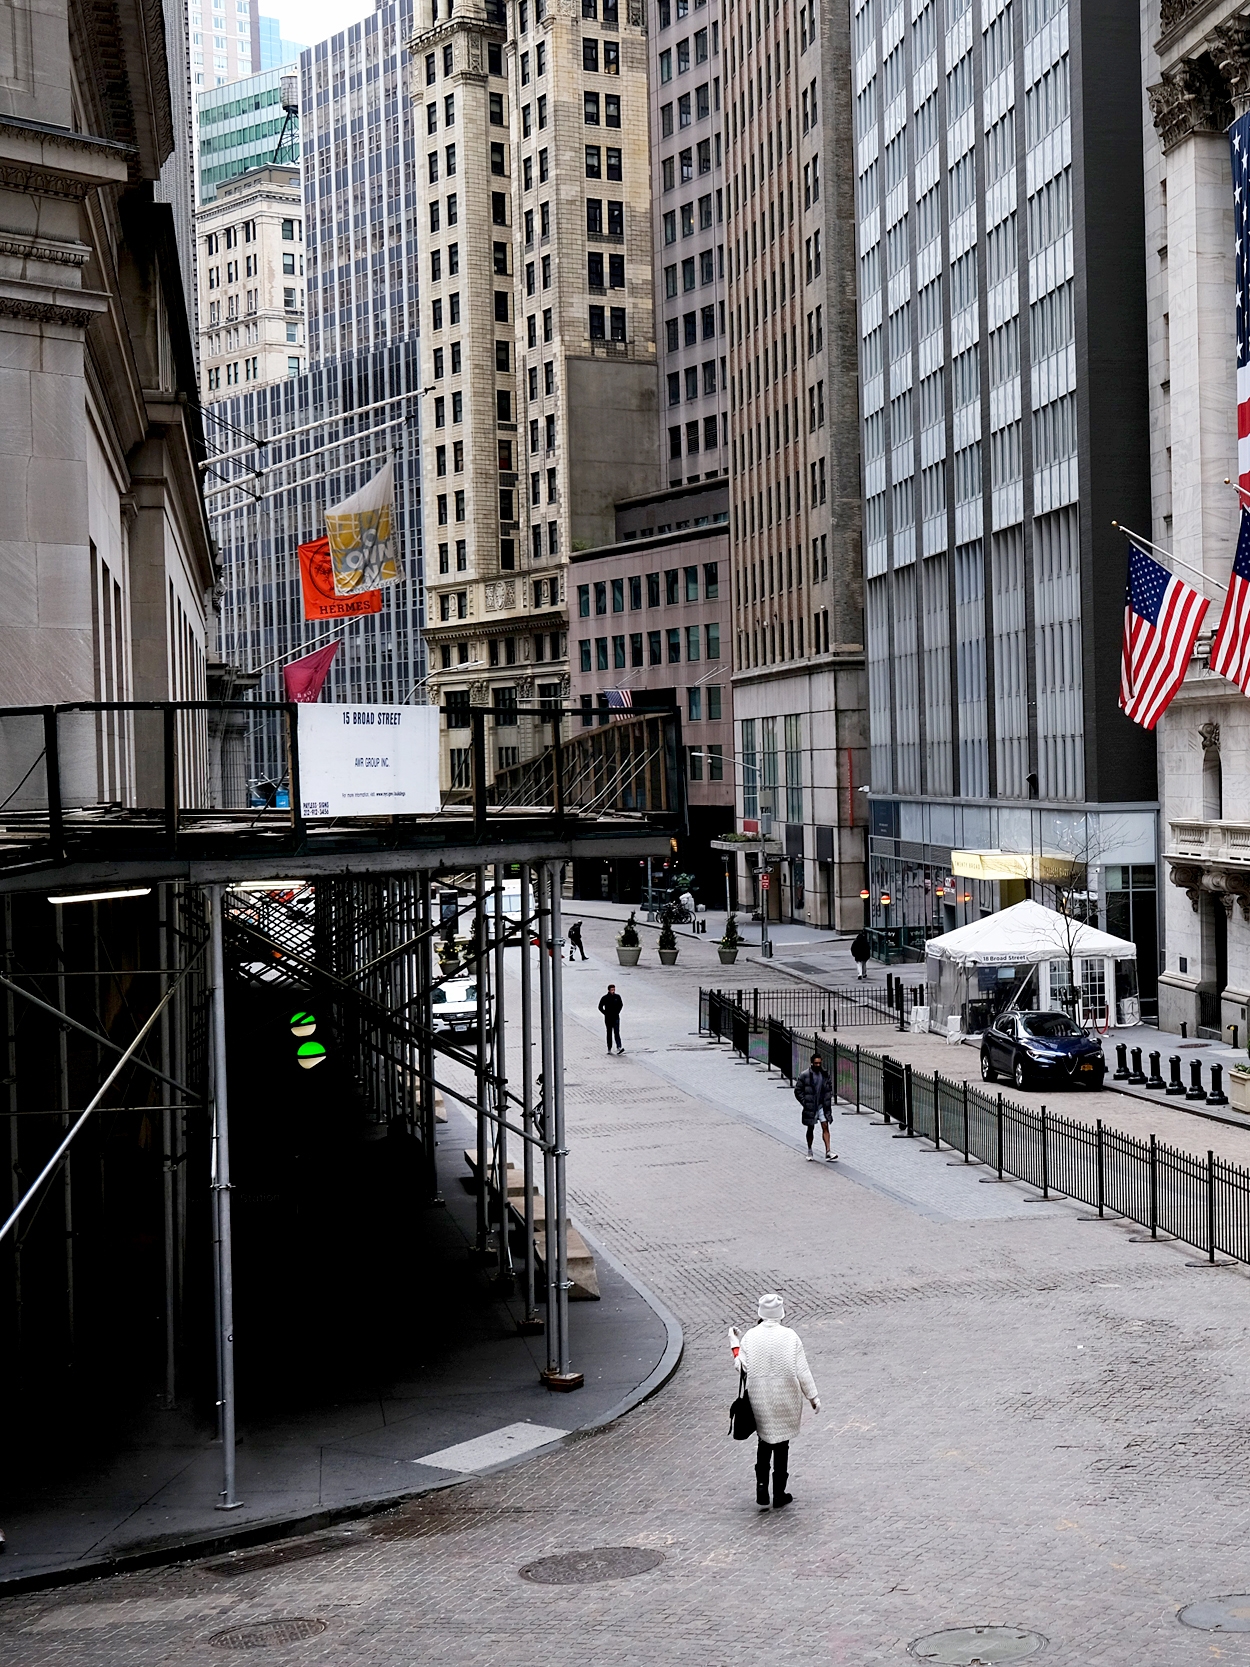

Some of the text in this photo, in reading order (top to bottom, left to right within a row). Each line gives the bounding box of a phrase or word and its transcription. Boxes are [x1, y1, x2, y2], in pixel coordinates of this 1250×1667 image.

[319, 601, 371, 614] HERMES
[342, 711, 402, 726] 15 BROAD STREET
[365, 757, 380, 768] GROUP
